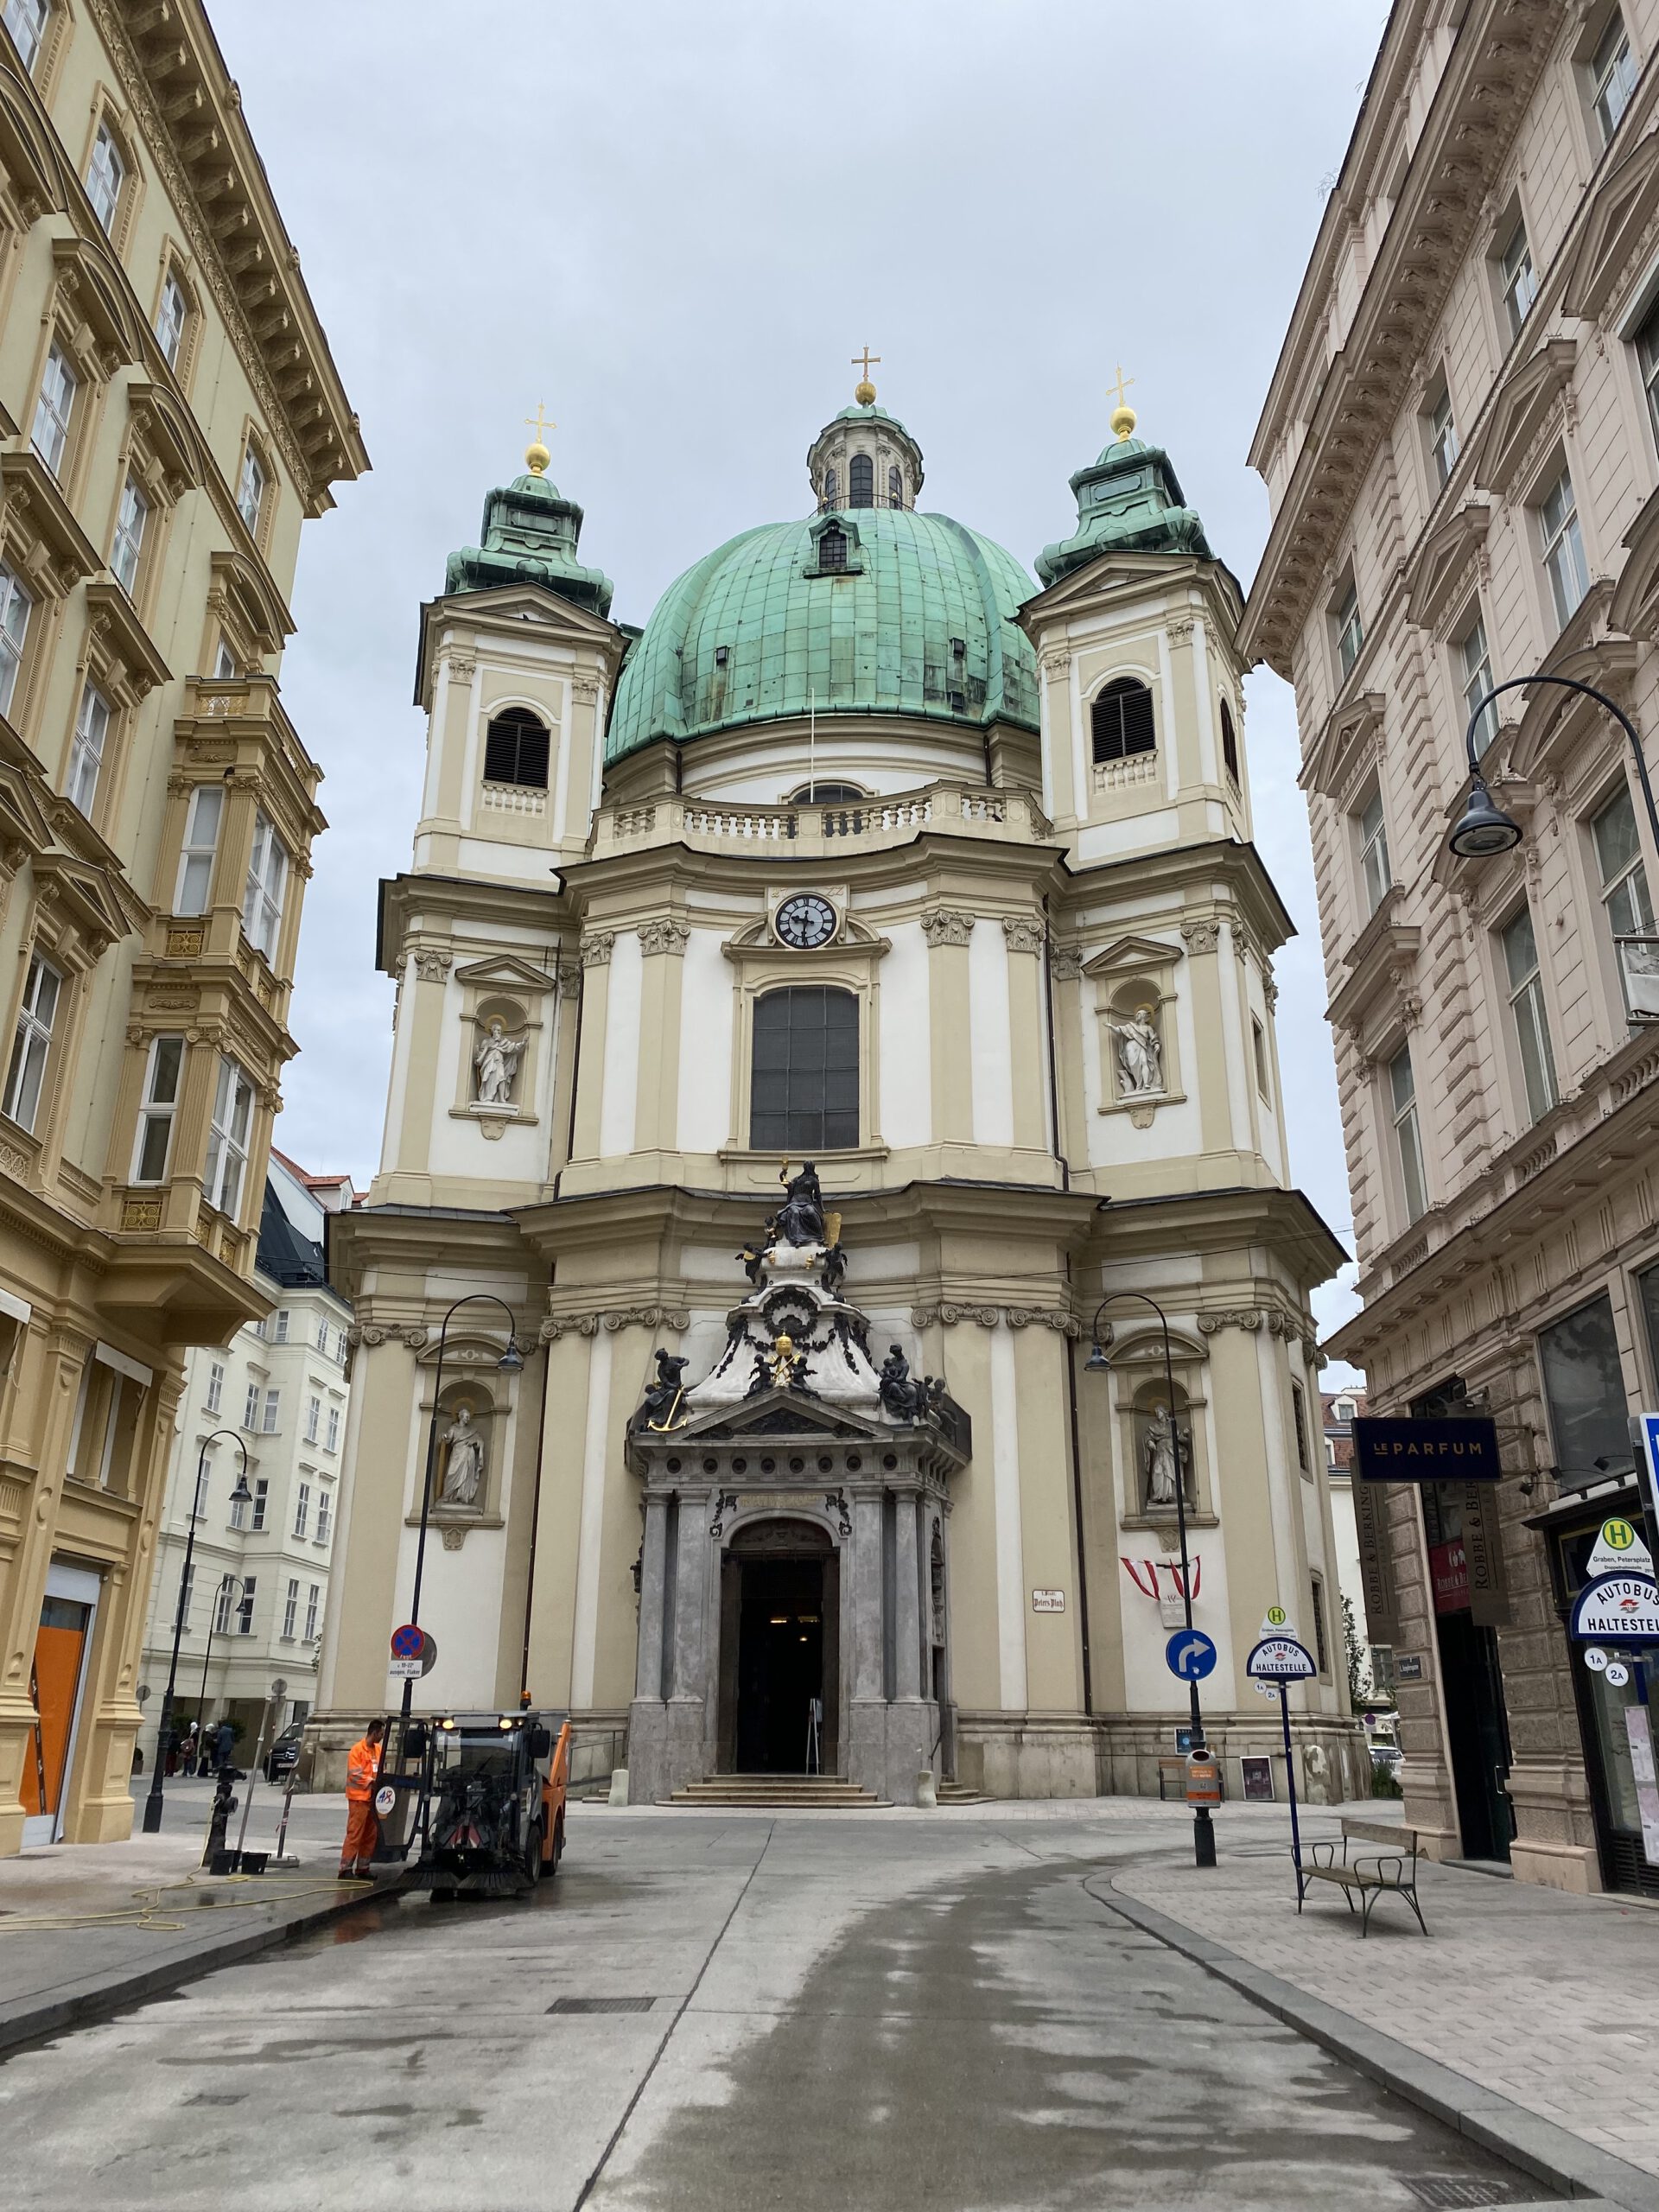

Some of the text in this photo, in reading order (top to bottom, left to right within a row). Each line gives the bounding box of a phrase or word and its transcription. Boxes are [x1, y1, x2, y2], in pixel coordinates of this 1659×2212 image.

[1393, 1442, 1482, 1455] PARFUM
[1359, 1485, 1375, 1549] BERKING
[1469, 1516, 1482, 1528] &
[1610, 1524, 1627, 1544] H
[1471, 1533, 1489, 1591] ROBBE
[1618, 1556, 1651, 1565] Petersplatz
[1366, 1568, 1382, 1616] ROBBE
[1597, 1582, 1659, 1605] AUTOBUS
[1272, 1610, 1282, 1622] H
[1262, 1643, 1300, 1657] AUTOBUS
[1590, 1655, 1603, 1664] 1A
[1256, 1663, 1306, 1672] HALTESTELLE
[1611, 1669, 1624, 1680] 2A
